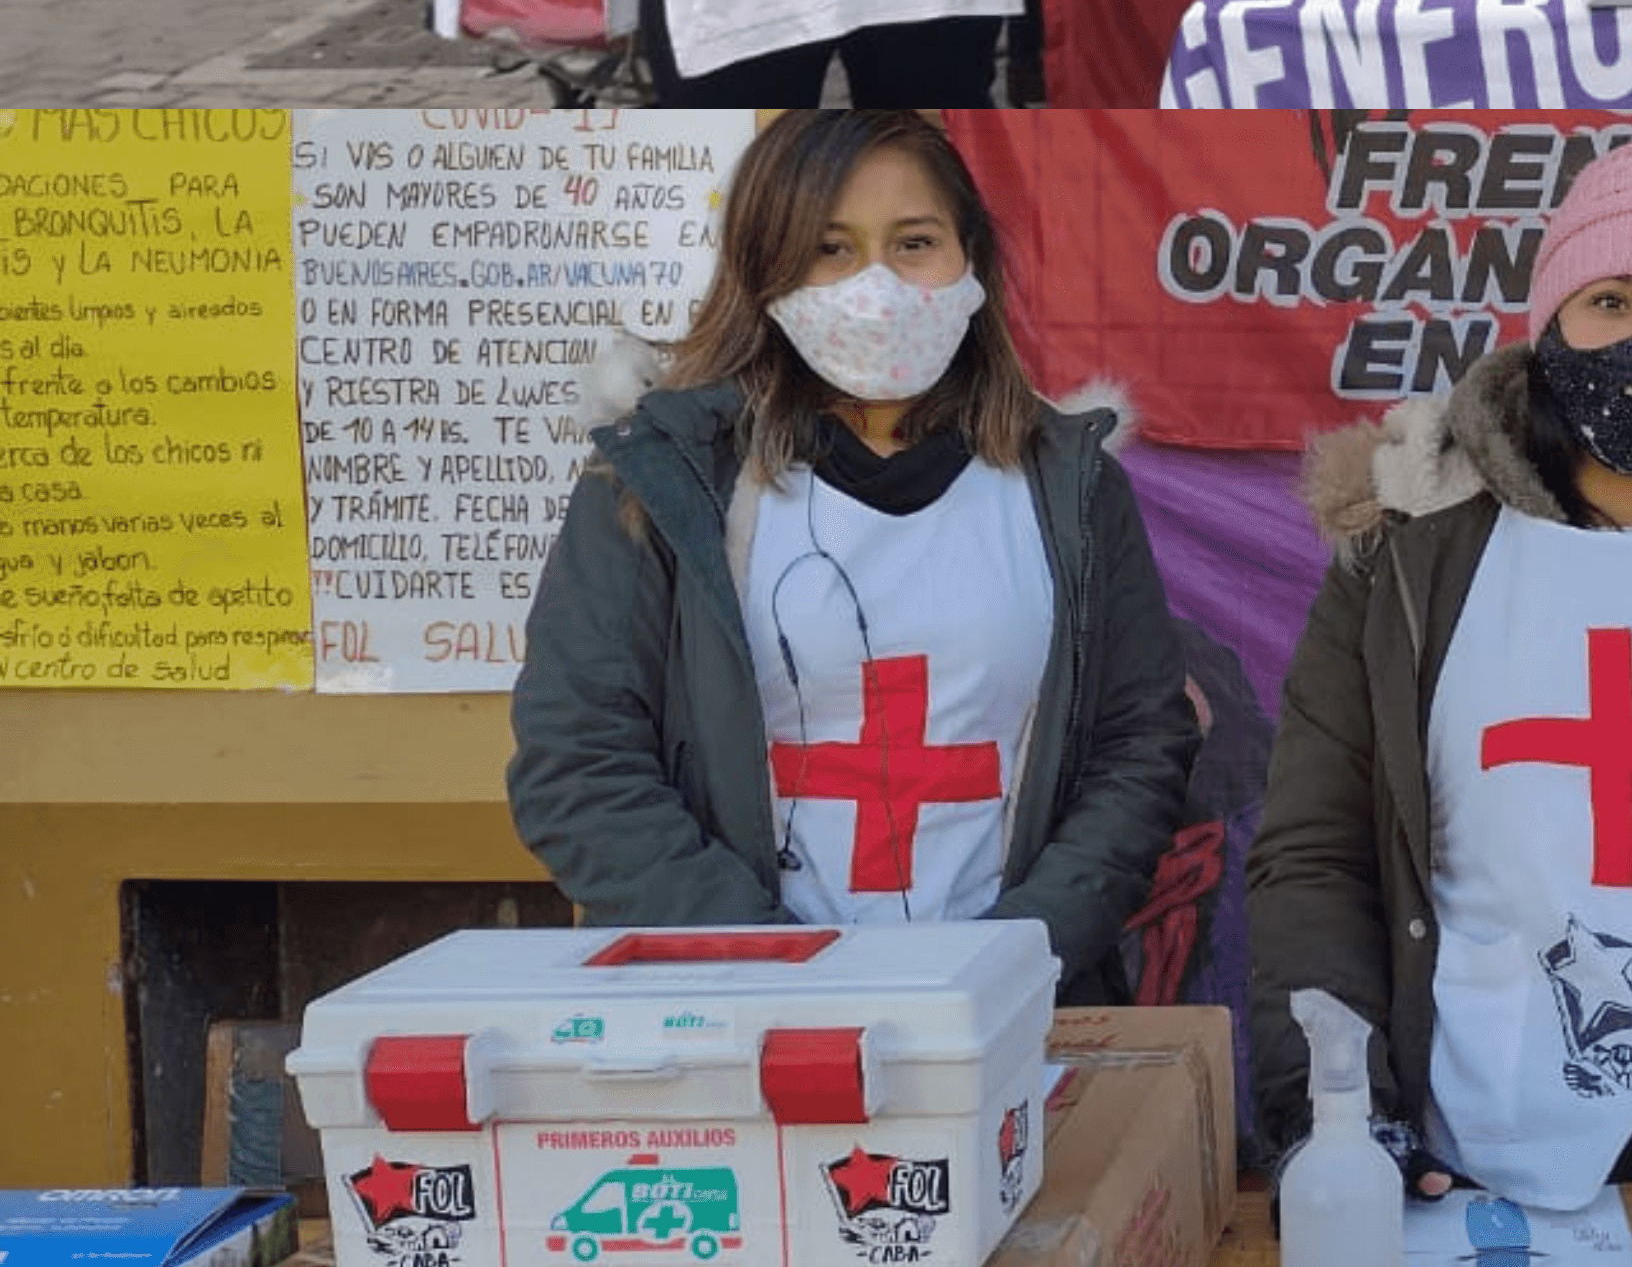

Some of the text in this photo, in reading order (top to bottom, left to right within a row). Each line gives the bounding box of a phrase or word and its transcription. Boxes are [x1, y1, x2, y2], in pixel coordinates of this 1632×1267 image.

[540, 145, 570, 170] DE
[585, 143, 616, 170] TU
[627, 142, 716, 172] FAMILIA
[169, 172, 240, 199] PARA
[313, 176, 685, 211] SON MAYORES DE 40 AÑOS
[215, 205, 253, 237] LA
[300, 219, 406, 250] PUEDEN
[432, 220, 650, 250] EMPADRONARSE
[79, 239, 111, 275] LA
[131, 246, 283, 275] NEUMONIA
[328, 300, 357, 326] EN
[371, 298, 449, 327] FORMA
[468, 299, 624, 328] PRESENCIAL
[641, 299, 673, 326] EN
[300, 335, 412, 366] CENTRO
[432, 336, 461, 365] DE
[1332, 305, 1498, 399] EN
[302, 377, 316, 408] Y
[327, 375, 441, 408] RIESTRA
[455, 375, 487, 407] DE
[305, 420, 336, 445] DE
[341, 416, 374, 444] 10
[382, 416, 397, 445] A
[493, 416, 531, 445] TE
[60, 434, 93, 467] de
[104, 430, 144, 465] los
[152, 433, 232, 466] chicos
[306, 453, 406, 484] NOMBRE
[418, 454, 433, 480] Y
[455, 494, 530, 524] FECHA
[441, 529, 557, 562] TELÉFON
[321, 620, 530, 663] FOL SALU
[536, 1128, 737, 1150] PRIMEROS AUXILIOS
[414, 1169, 471, 1216] FOL
[891, 1161, 947, 1211] FOL
